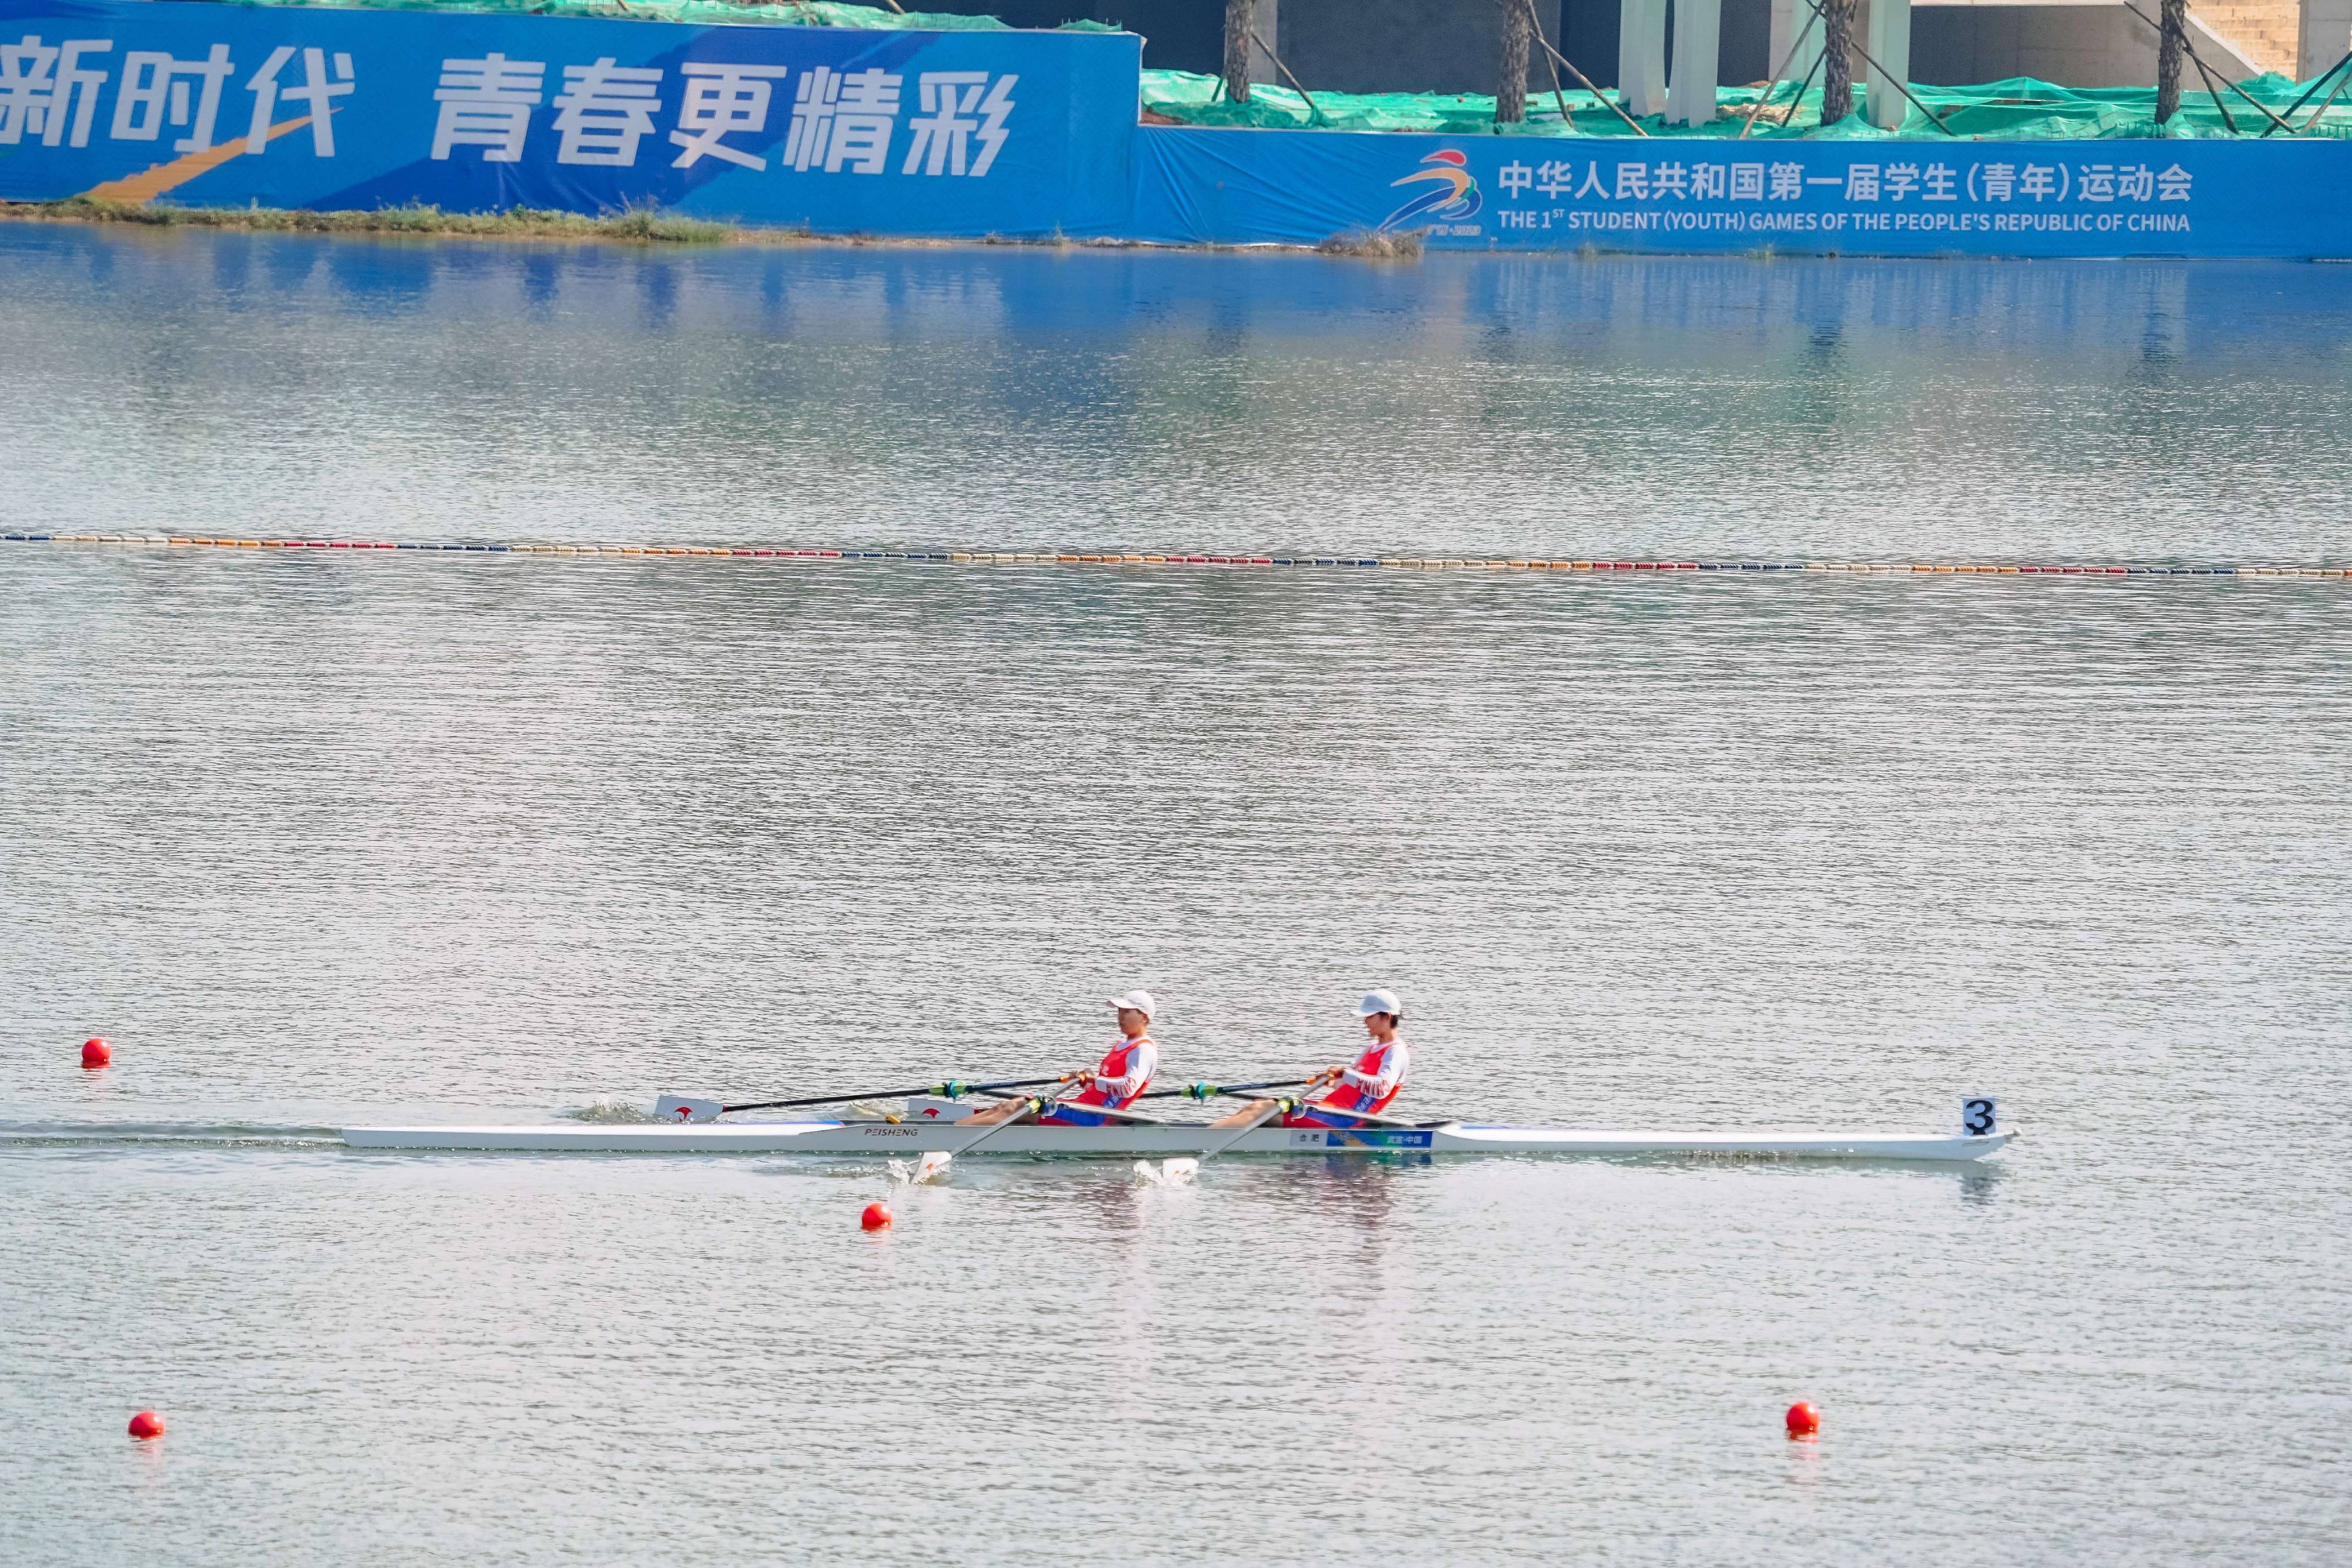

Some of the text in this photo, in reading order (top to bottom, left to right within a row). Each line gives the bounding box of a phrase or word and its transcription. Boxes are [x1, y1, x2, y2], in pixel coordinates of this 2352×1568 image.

[0, 35, 1020, 177] 新时代 青春更精彩
[1498, 210, 1537, 229] THE
[1568, 211, 1661, 230] STUDENT
[1663, 210, 1746, 231] (YOUTH)
[1749, 212, 1818, 230] GAMES
[1821, 213, 1848, 230] OF
[1852, 213, 1891, 230] THE
[1895, 213, 1990, 230] PEOPLE'S
[1994, 214, 2093, 231] REPUBLIC
[2097, 214, 2124, 231] OF
[2127, 214, 2191, 232] CHINA
[1966, 1100, 1994, 1131] 3
